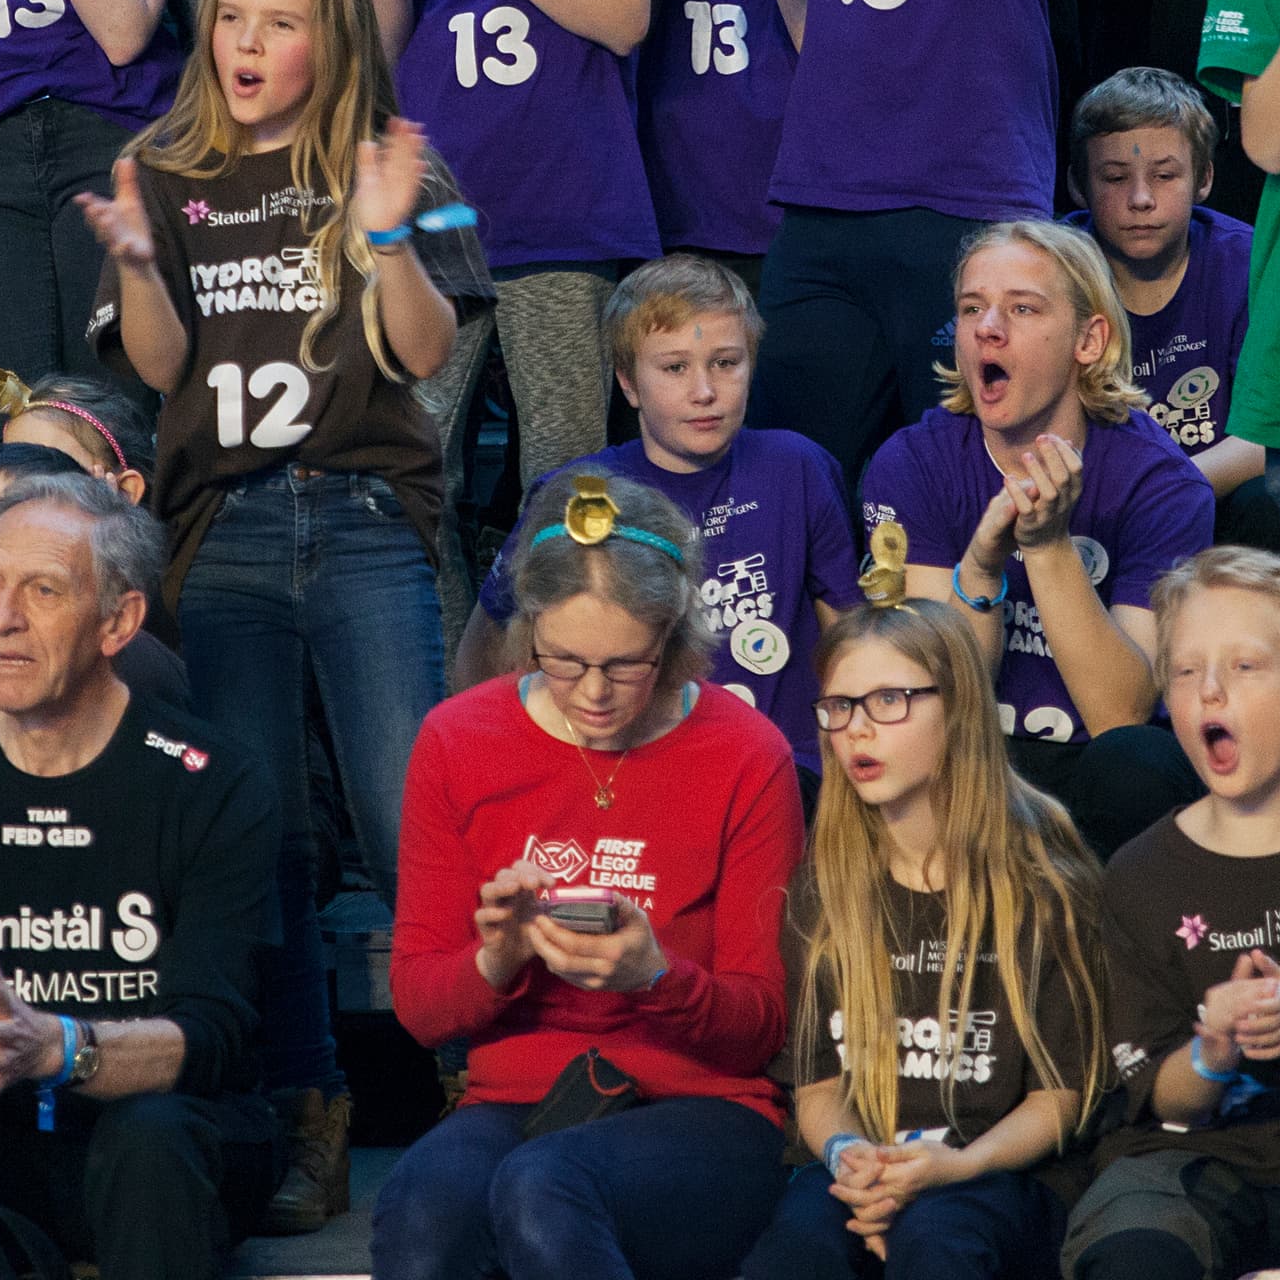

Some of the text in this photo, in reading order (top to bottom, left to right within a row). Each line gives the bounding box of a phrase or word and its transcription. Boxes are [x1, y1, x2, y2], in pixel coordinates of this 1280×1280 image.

[448, 6, 538, 89] 13
[683, 1, 750, 76] 13
[207, 208, 260, 228] Statoil
[195, 285, 329, 318] YNAMIC
[206, 361, 313, 449] 12
[185, 749, 208, 770] 24
[27, 809, 68, 823] TEAM
[1, 826, 92, 847] FED GED
[594, 838, 645, 857] FIRST
[591, 854, 637, 873] LEGO
[589, 870, 657, 892] LEAGUE
[1208, 927, 1265, 952] Statoil
